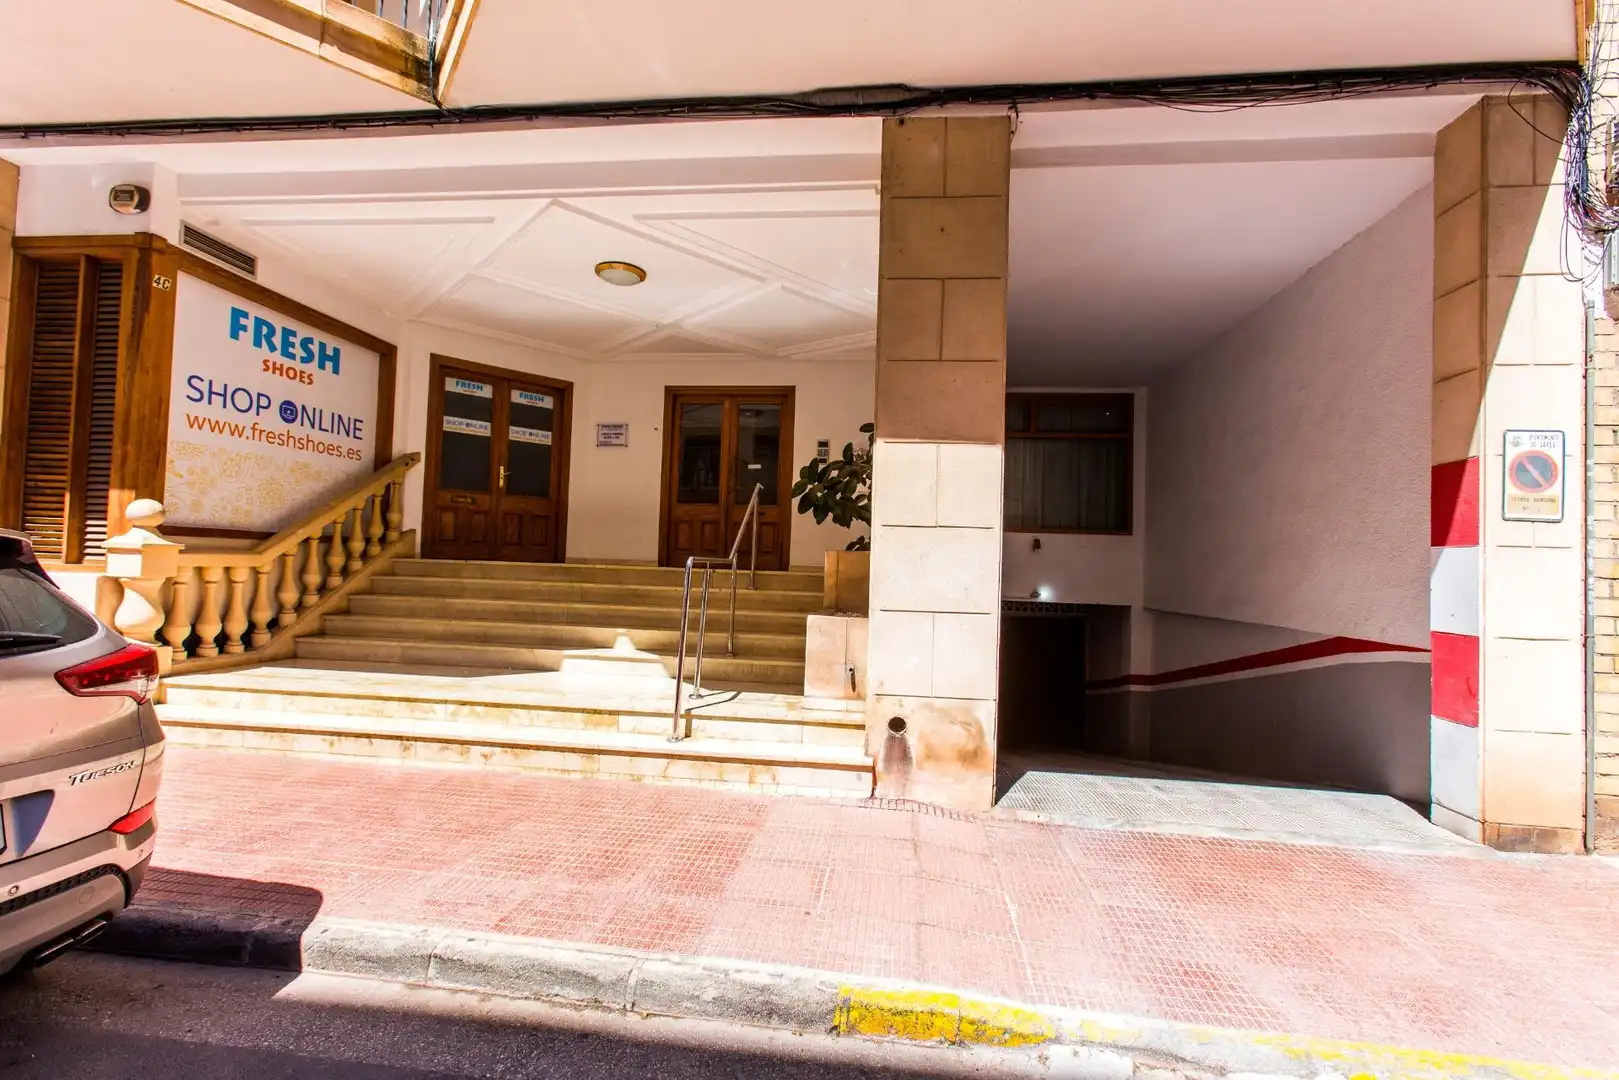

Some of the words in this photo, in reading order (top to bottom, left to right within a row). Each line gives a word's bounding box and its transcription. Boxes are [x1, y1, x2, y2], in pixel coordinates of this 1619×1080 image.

[153, 276, 171, 290] 4C
[228, 306, 341, 376] FRESH
[262, 358, 315, 386] SHOES
[186, 374, 272, 417] SHOP
[455, 380, 484, 392] FRESH
[519, 392, 545, 403] FRESH
[185, 412, 362, 462] www.freshshoes.es
[68, 760, 136, 786] TUCSON
